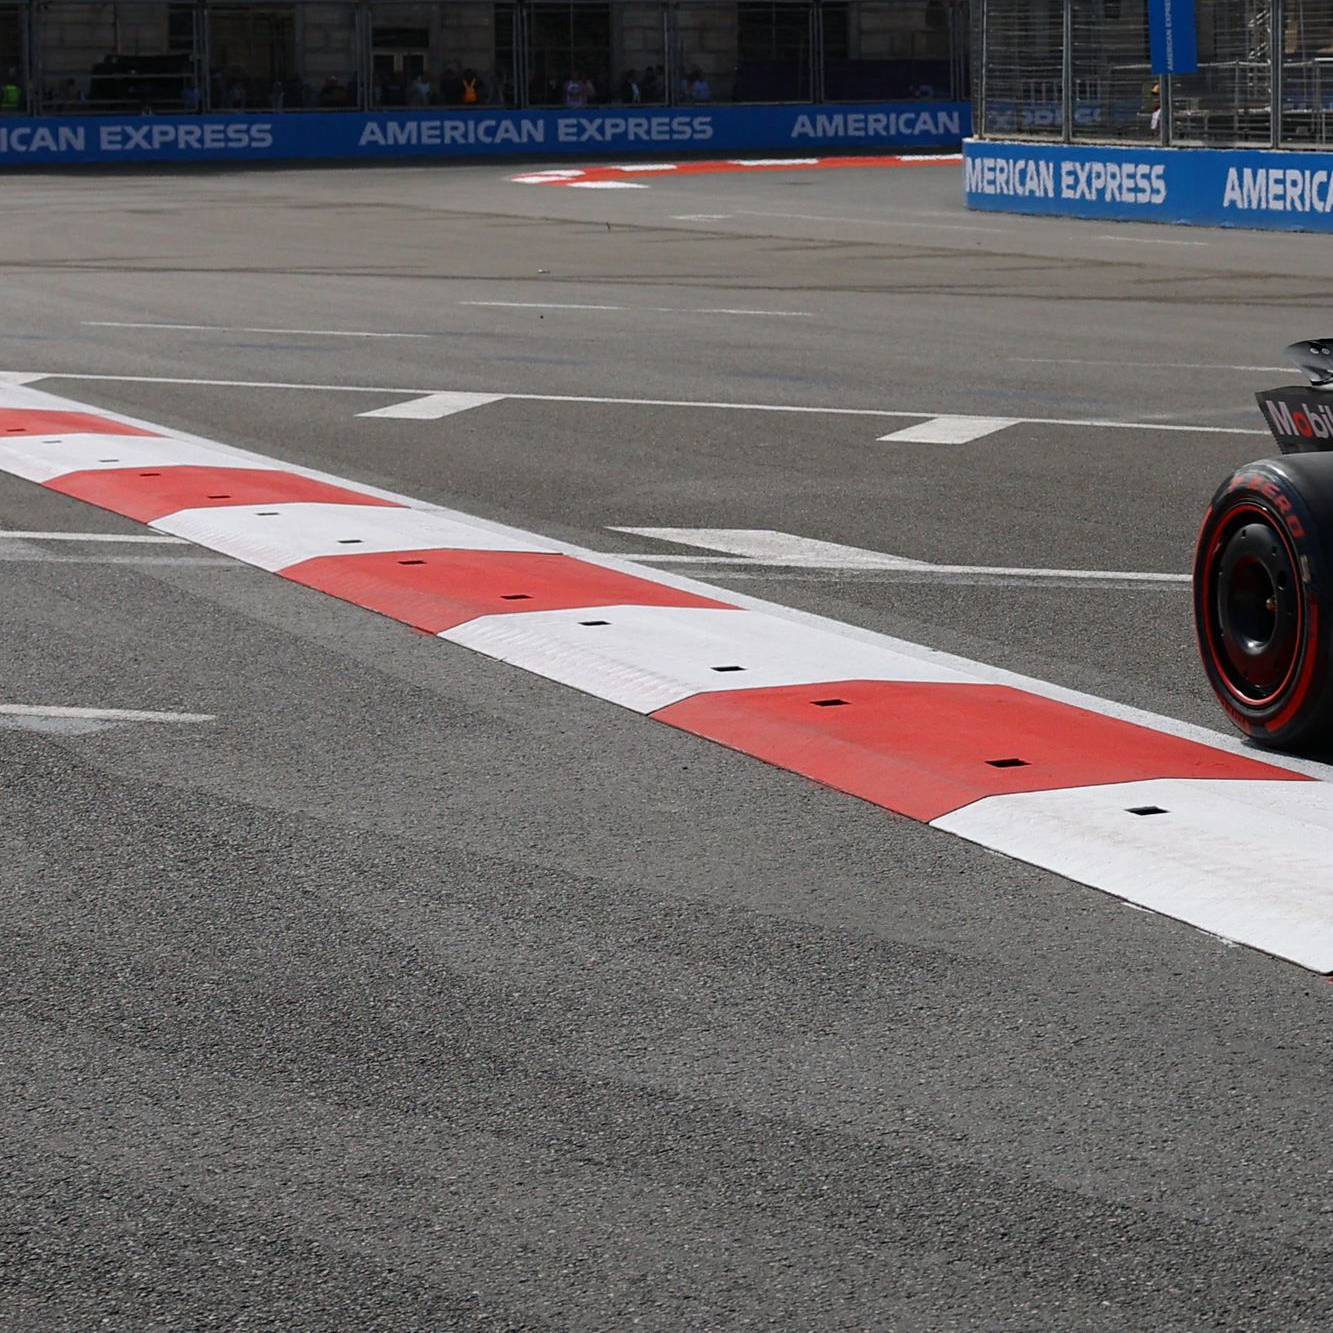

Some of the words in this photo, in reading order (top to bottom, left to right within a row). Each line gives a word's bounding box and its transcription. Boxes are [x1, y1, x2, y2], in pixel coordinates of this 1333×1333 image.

[99, 121, 274, 151] EXPRESS
[358, 117, 545, 147] AMERICAN
[556, 115, 715, 143] EXPRESS
[790, 109, 960, 139] AMERICAN
[1060, 160, 1167, 204] EXPRESS
